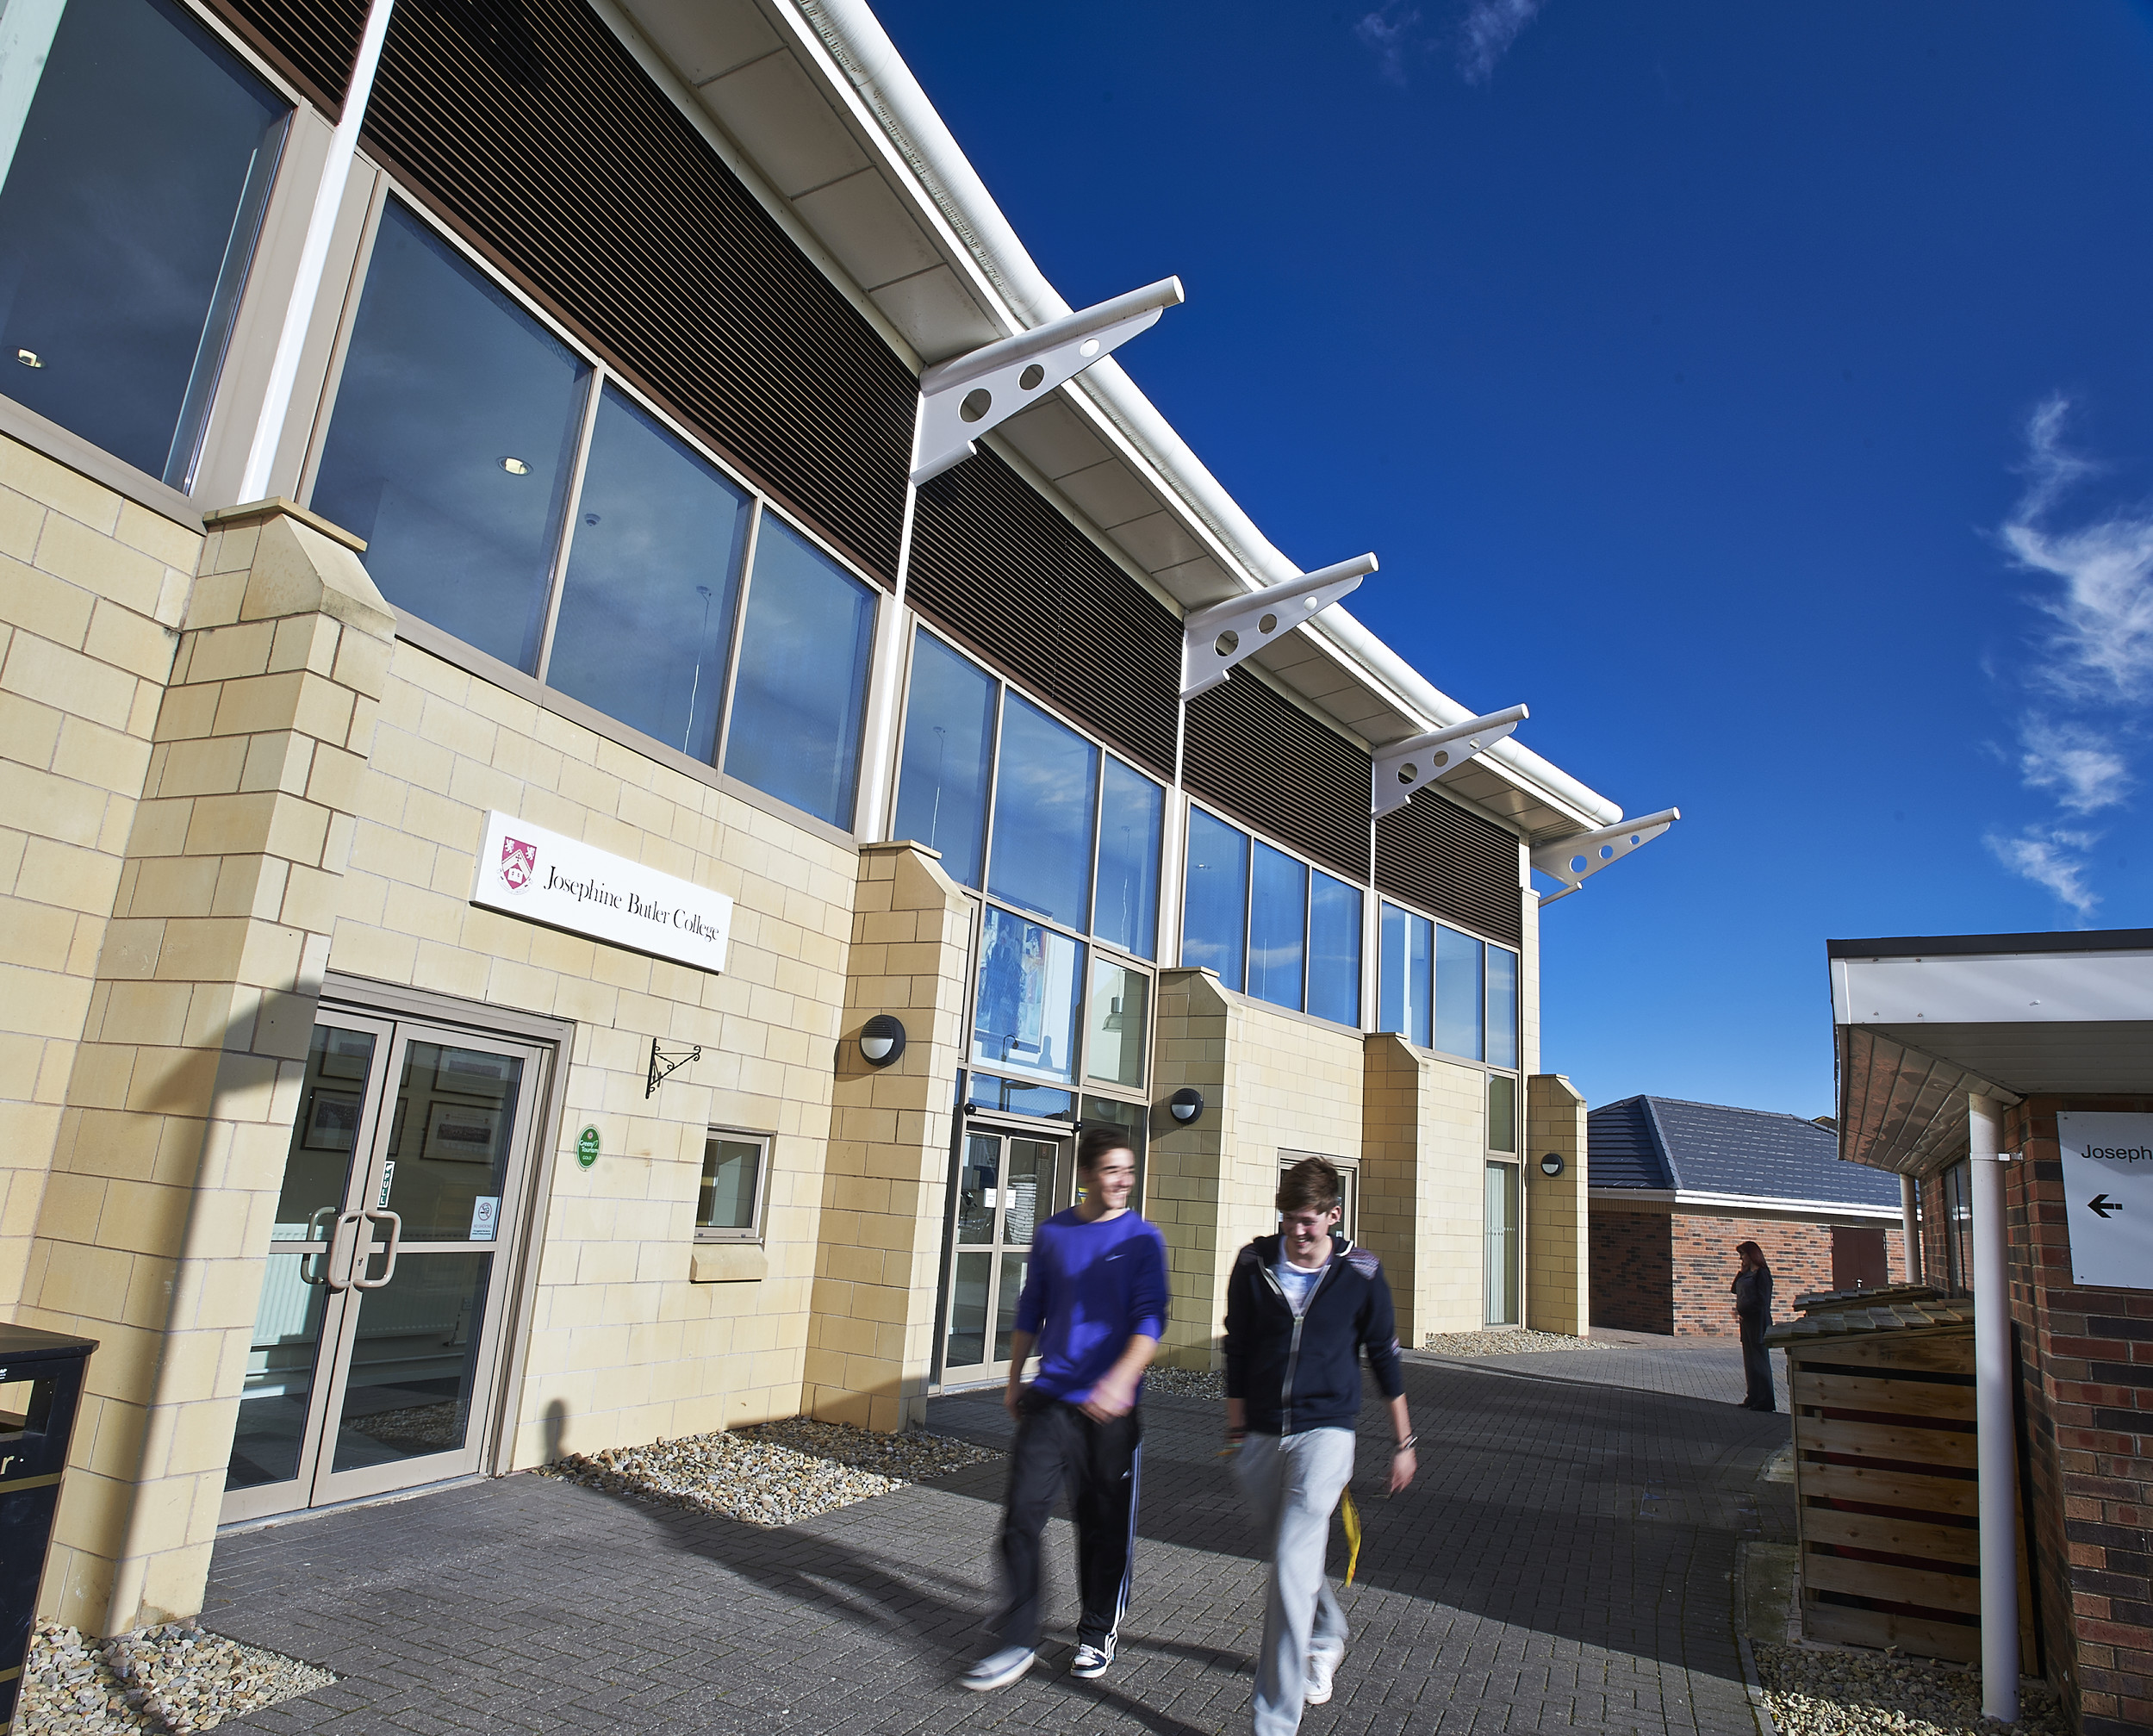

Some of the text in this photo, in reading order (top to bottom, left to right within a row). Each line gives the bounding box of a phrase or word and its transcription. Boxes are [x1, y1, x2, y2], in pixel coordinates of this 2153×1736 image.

[543, 865, 719, 943] Josephine Butler College
[2081, 1144, 2153, 1163] Joseph
[380, 1173, 390, 1204] PULL
